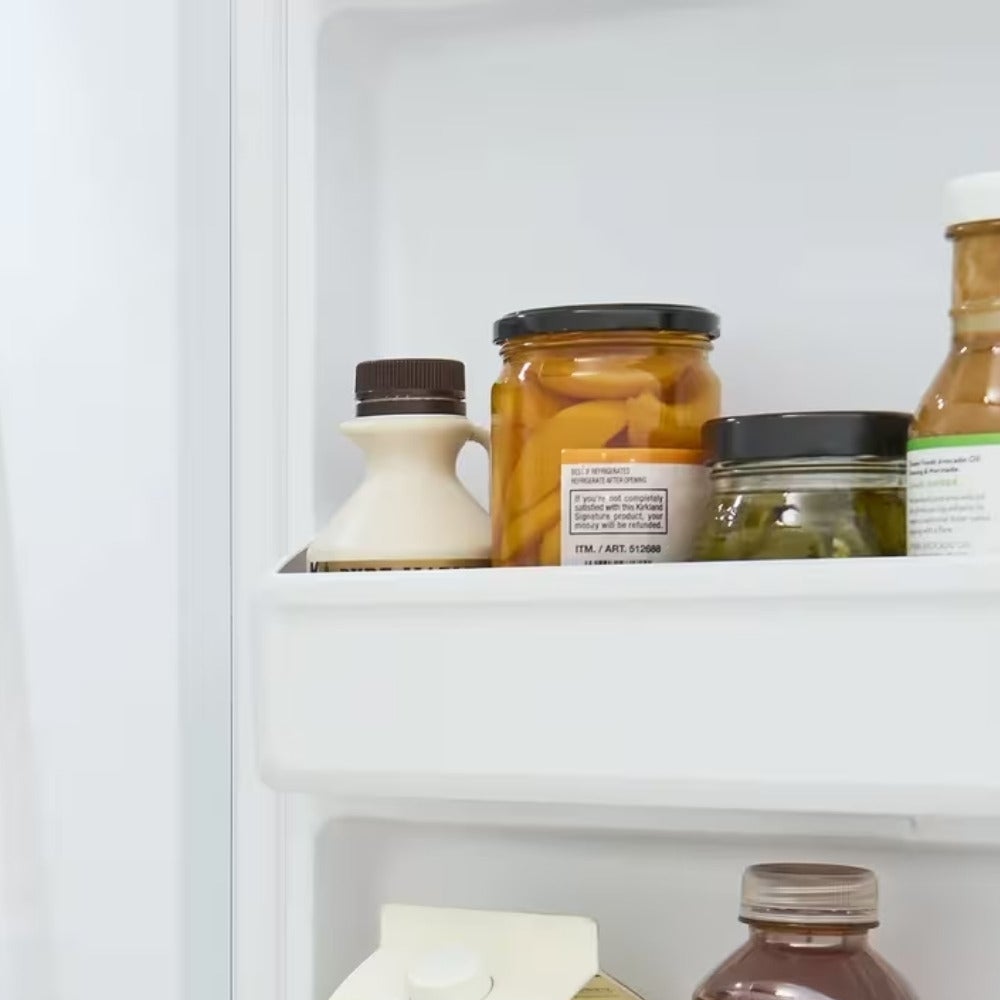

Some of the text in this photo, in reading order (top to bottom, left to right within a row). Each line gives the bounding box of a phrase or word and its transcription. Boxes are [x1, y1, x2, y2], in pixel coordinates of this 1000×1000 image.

[624, 494, 664, 503] completely
[606, 503, 620, 511] with
[622, 503, 634, 511] this
[636, 503, 663, 511] Kirkland
[575, 513, 610, 521] Signature
[647, 513, 663, 521] your
[601, 521, 615, 529] will
[617, 521, 626, 529] be
[628, 521, 664, 529] refunded.
[575, 545, 596, 553] ITM.
[605, 545, 627, 553] ART.
